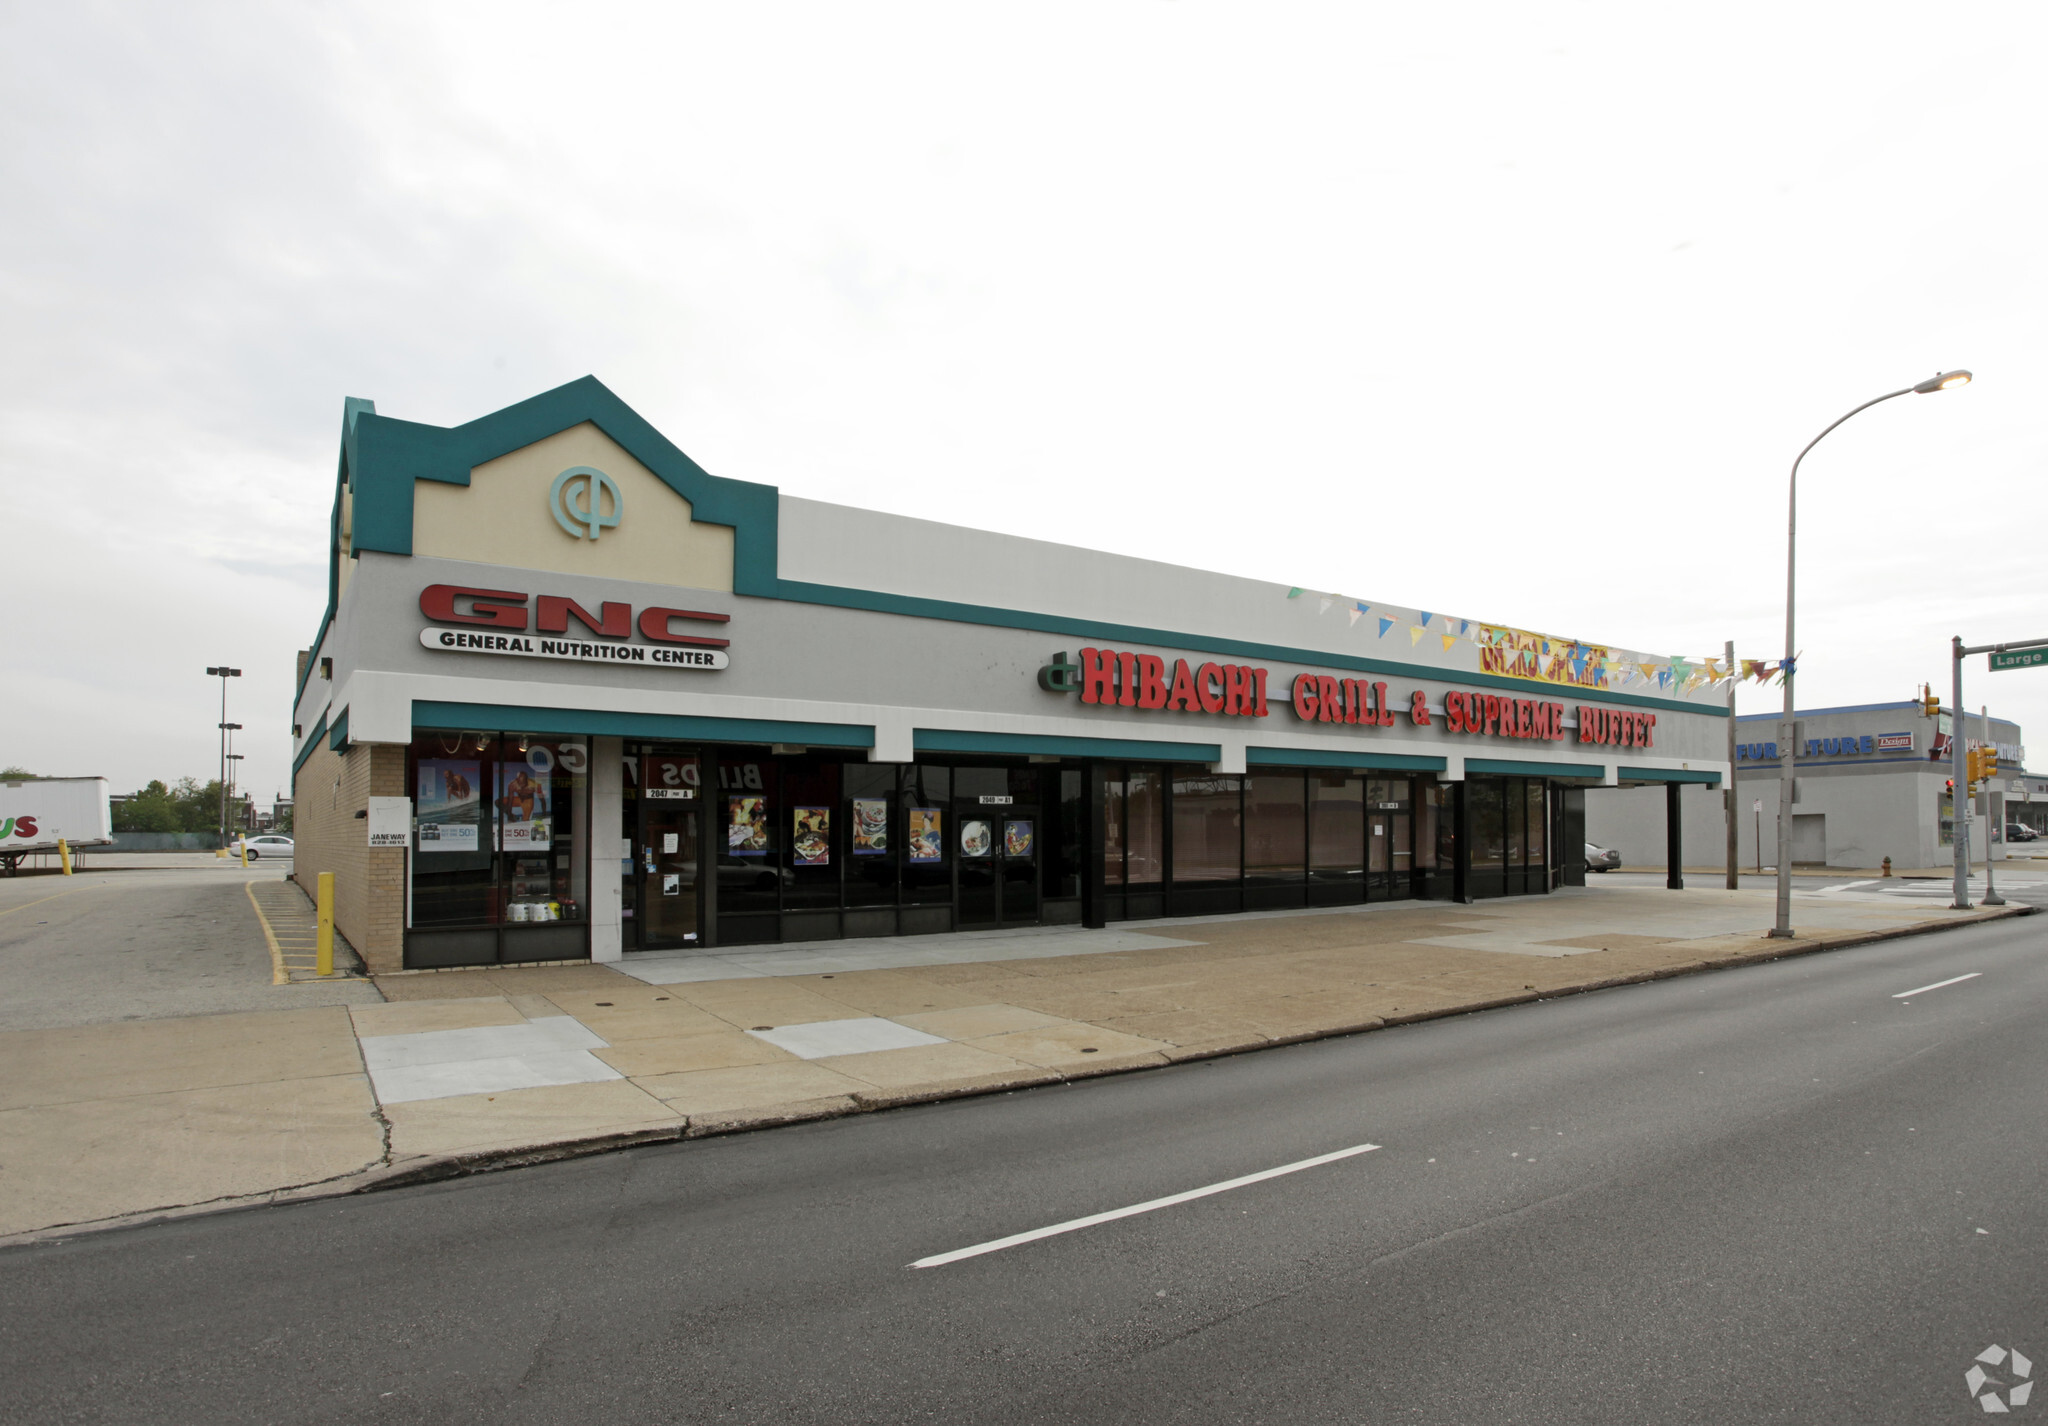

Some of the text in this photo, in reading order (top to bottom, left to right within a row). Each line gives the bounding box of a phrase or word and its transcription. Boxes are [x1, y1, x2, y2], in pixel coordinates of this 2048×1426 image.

[419, 584, 731, 647] GNC
[440, 631, 715, 667] GENERAL NUTRITION CENTER
[1996, 653, 2043, 666] Large
[1080, 647, 1656, 748] HIBACHI GRILL & SUPREME BUFFET
[1736, 735, 1873, 761] FURTURE
[651, 789, 668, 798] 2047
[371, 833, 406, 841] JANEWAY
